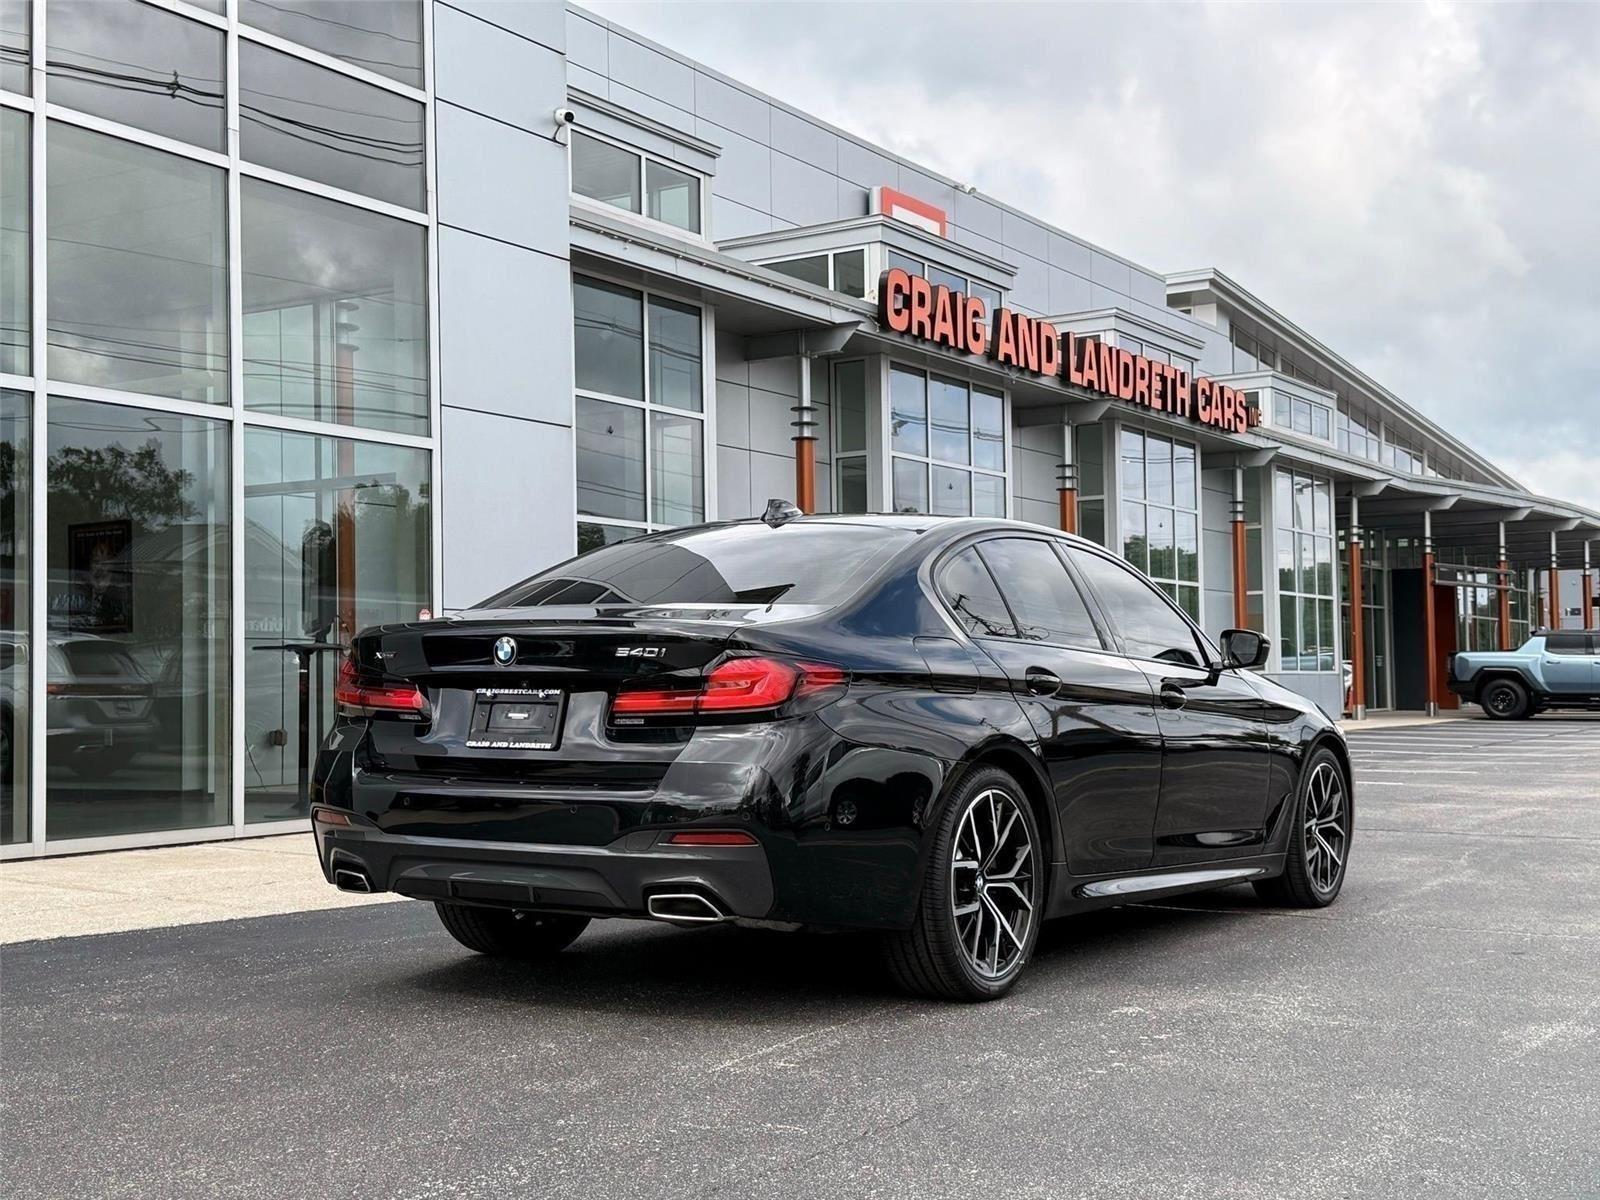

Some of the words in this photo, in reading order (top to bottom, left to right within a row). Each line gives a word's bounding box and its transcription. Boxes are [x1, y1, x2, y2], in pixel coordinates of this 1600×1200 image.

[884, 267, 986, 356] CRAIG
[997, 308, 1059, 377] AND
[1068, 331, 1191, 418] LANDRETH
[1197, 377, 1248, 434] CARS
